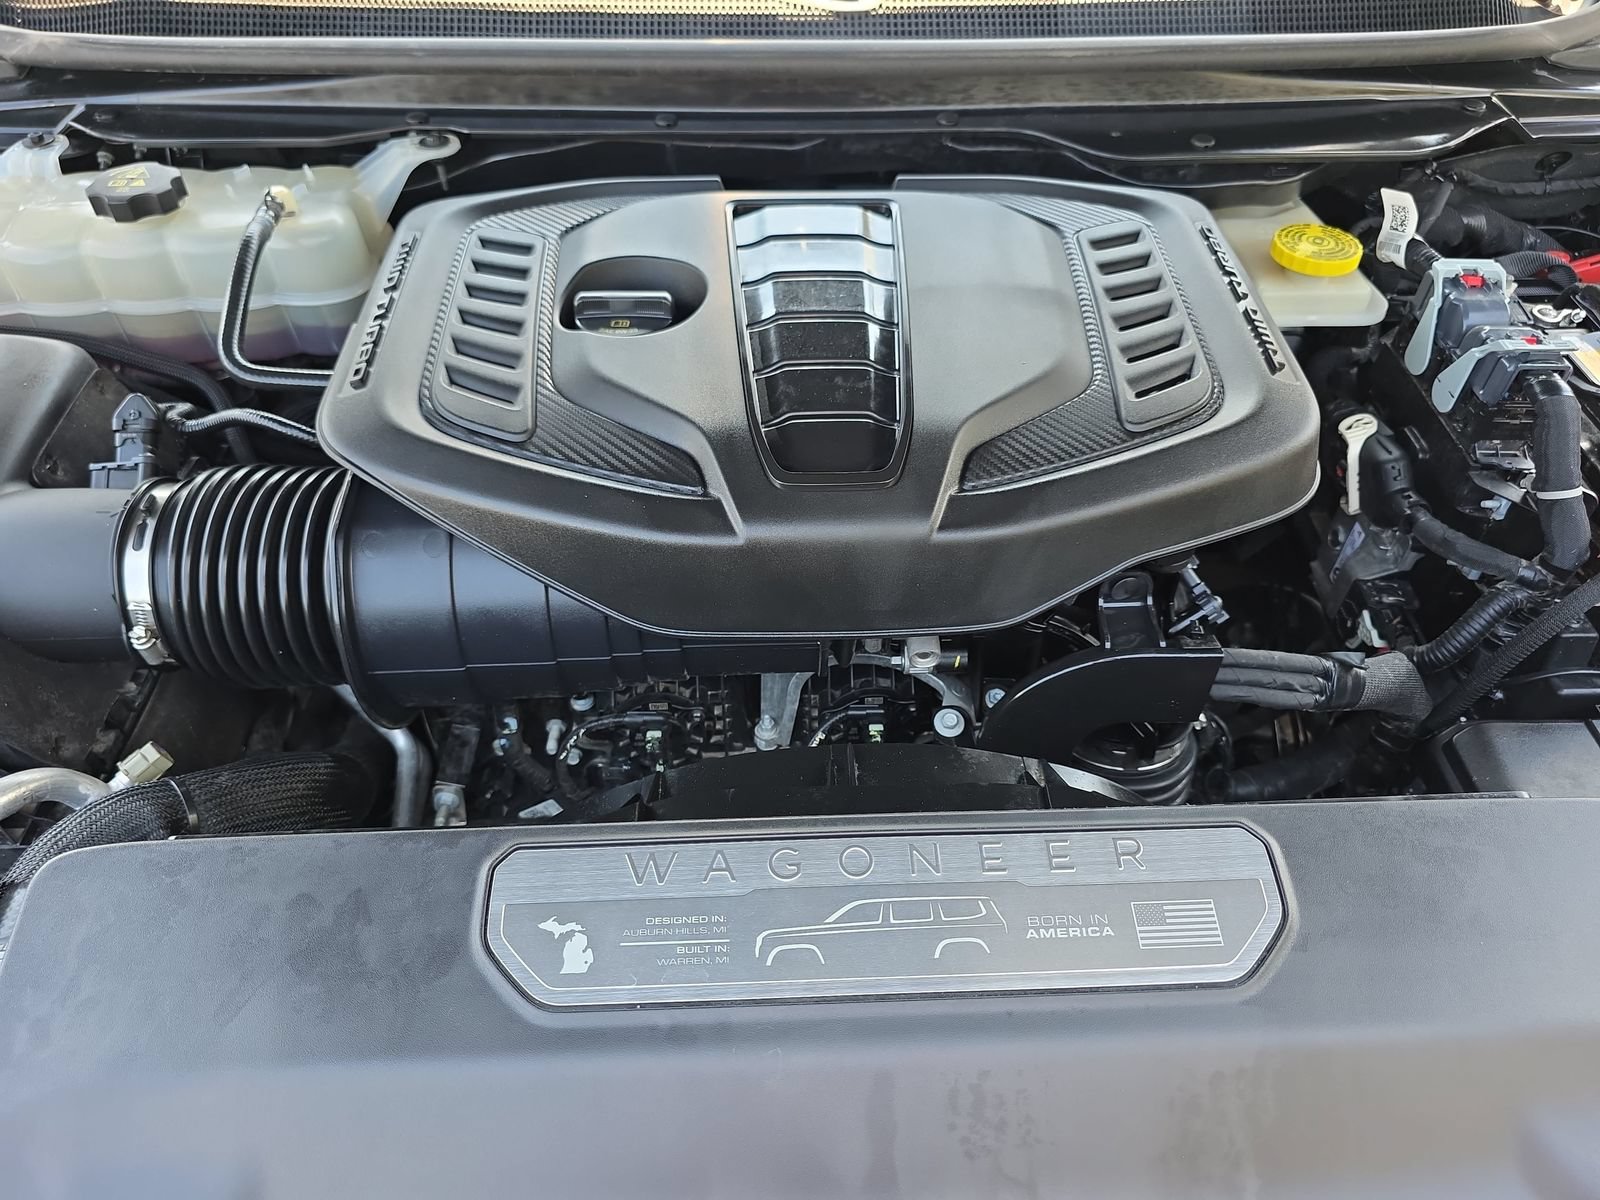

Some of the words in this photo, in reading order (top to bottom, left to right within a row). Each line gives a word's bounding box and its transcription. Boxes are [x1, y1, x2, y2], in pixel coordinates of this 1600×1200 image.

[624, 836, 1147, 886] WAGONEER
[645, 915, 709, 925] DESIGNED
[711, 915, 727, 923] IN:
[1027, 914, 1083, 927] BORN
[1090, 913, 1109, 925] IN
[622, 928, 673, 937] AUBURN
[675, 926, 711, 935] HILLS,
[1026, 926, 1115, 939] AMERICA
[676, 945, 712, 954] BUILT
[714, 944, 730, 953] IN:
[656, 957, 713, 966] WARREN,
[715, 956, 730, 964] MI
